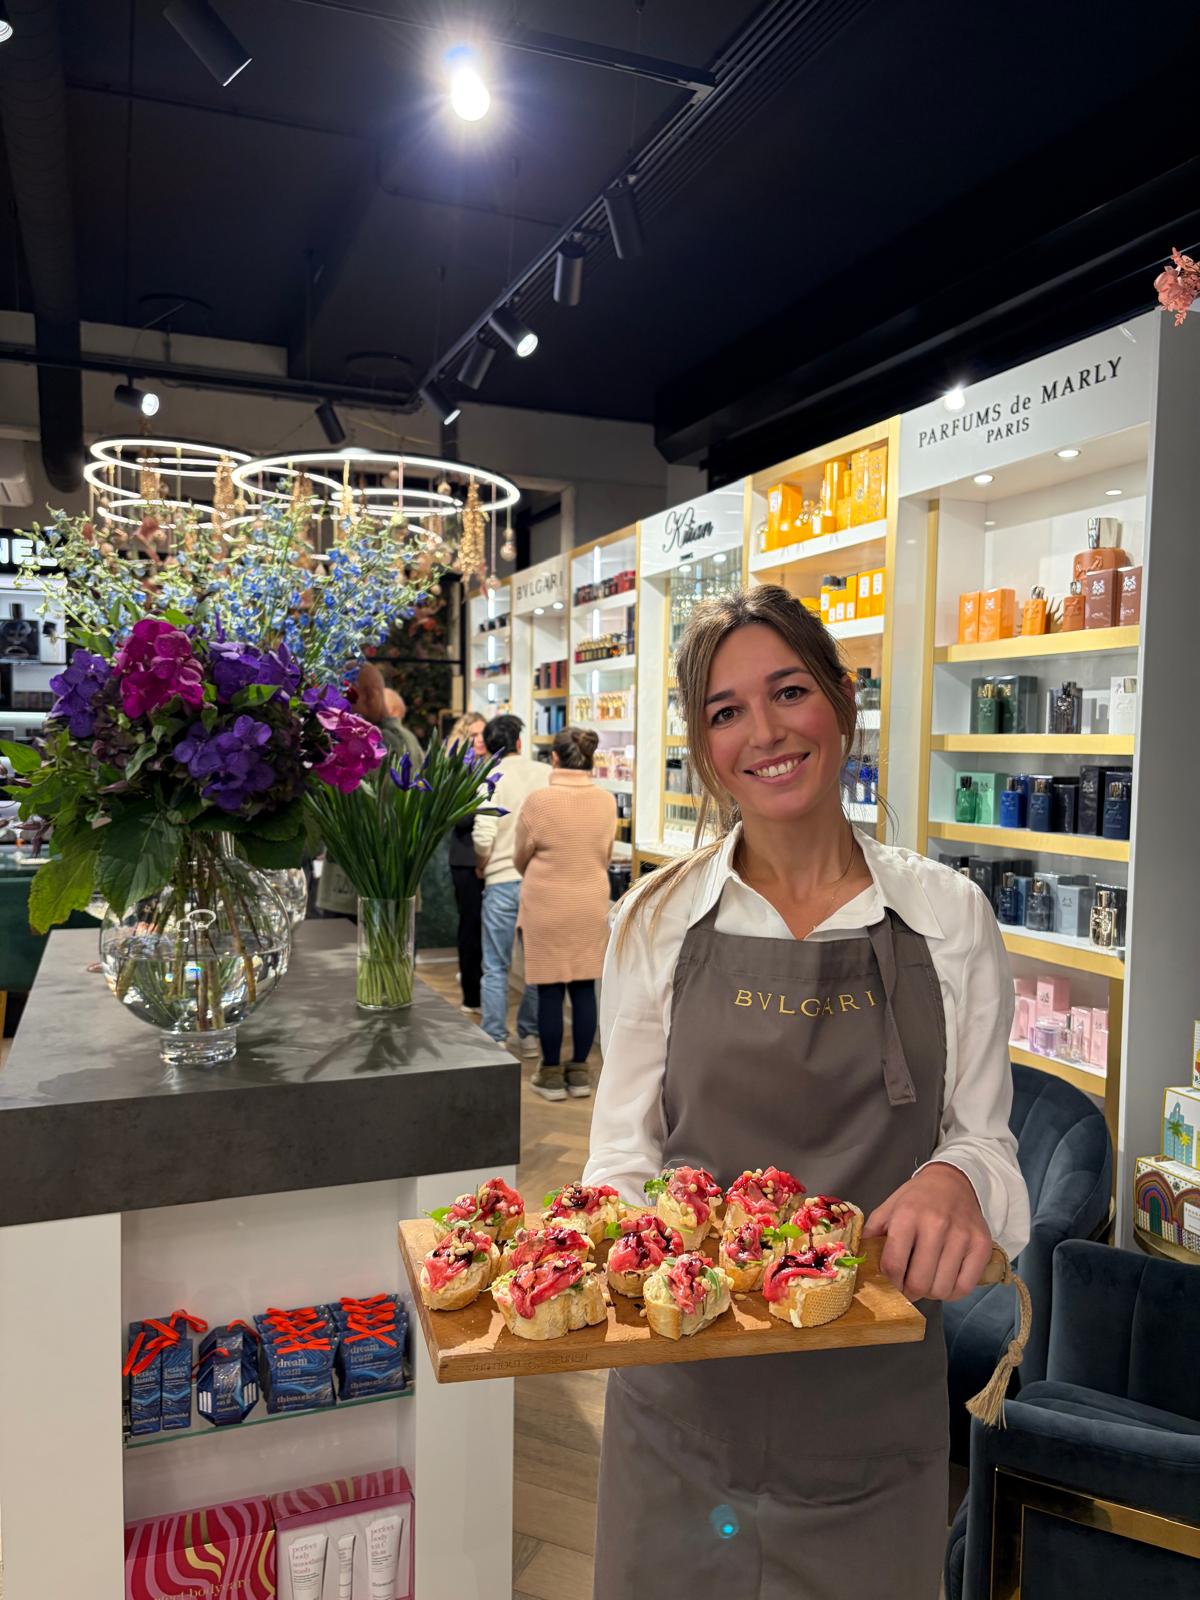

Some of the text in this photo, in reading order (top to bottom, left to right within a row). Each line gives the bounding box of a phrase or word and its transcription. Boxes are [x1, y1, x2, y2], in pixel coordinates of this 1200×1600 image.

[918, 356, 1122, 448] PARFUMS de MARLY
[986, 417, 1030, 443] PARIS
[516, 570, 564, 600] BVLGARI
[734, 989, 877, 1017] BVLGARI
[277, 1358, 308, 1368] dream
